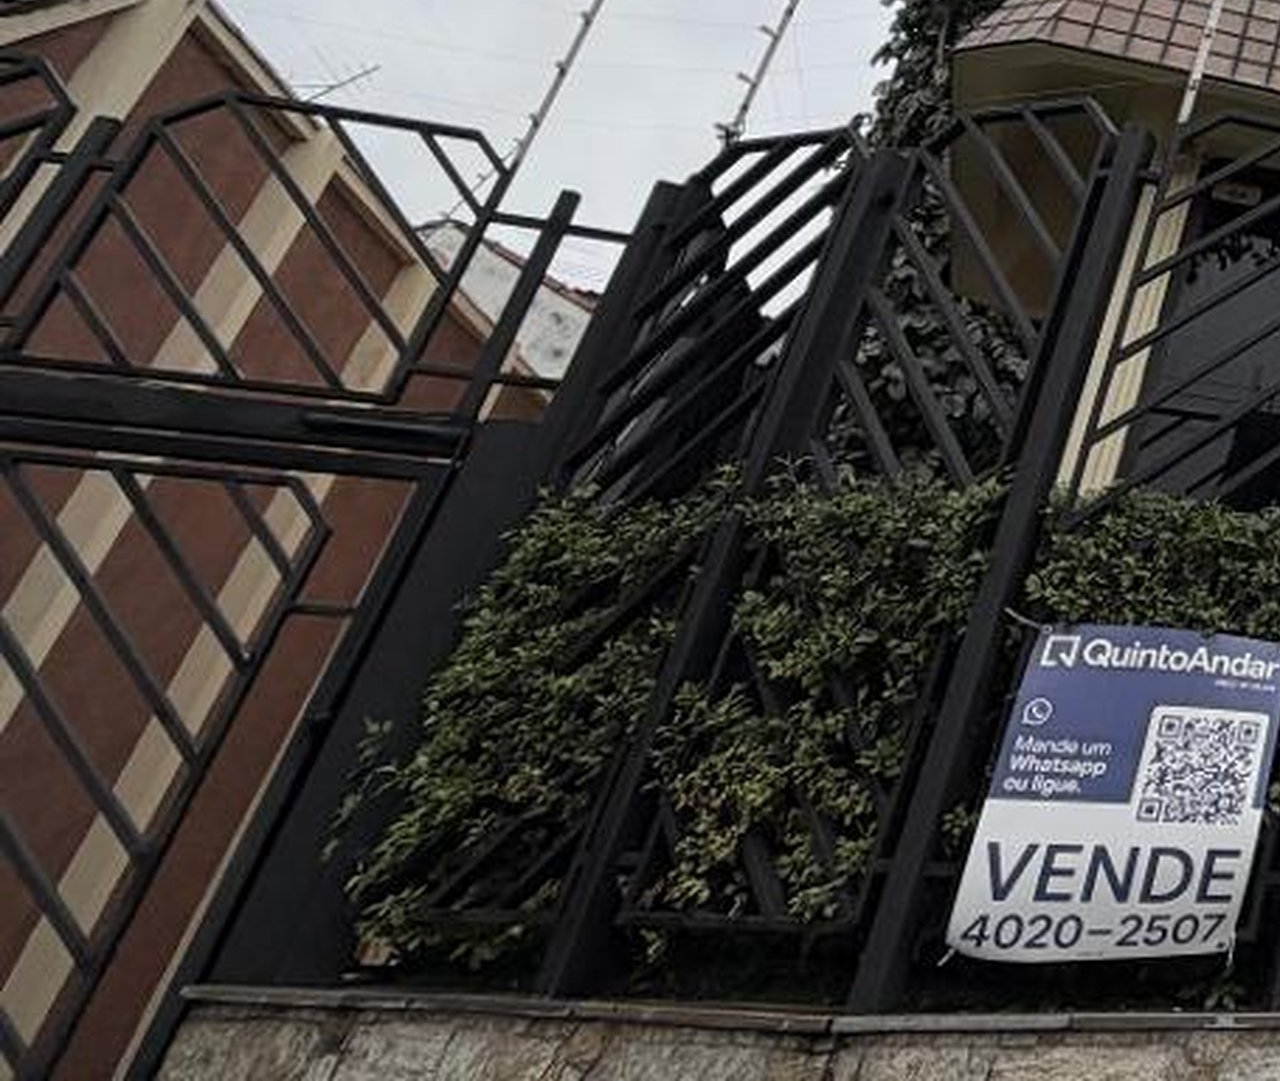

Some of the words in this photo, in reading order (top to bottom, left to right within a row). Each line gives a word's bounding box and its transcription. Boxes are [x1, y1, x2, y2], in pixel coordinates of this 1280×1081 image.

[1083, 638, 1280, 680] QuintoAndar
[1014, 735, 1080, 755] Mande
[1081, 742, 1112, 756] um
[1010, 754, 1107, 778] Whatsapp
[1003, 777, 1028, 792] ou
[1030, 774, 1082, 798] ligue.
[986, 841, 1241, 905] VENDE
[960, 913, 1227, 949] 4020-2507
